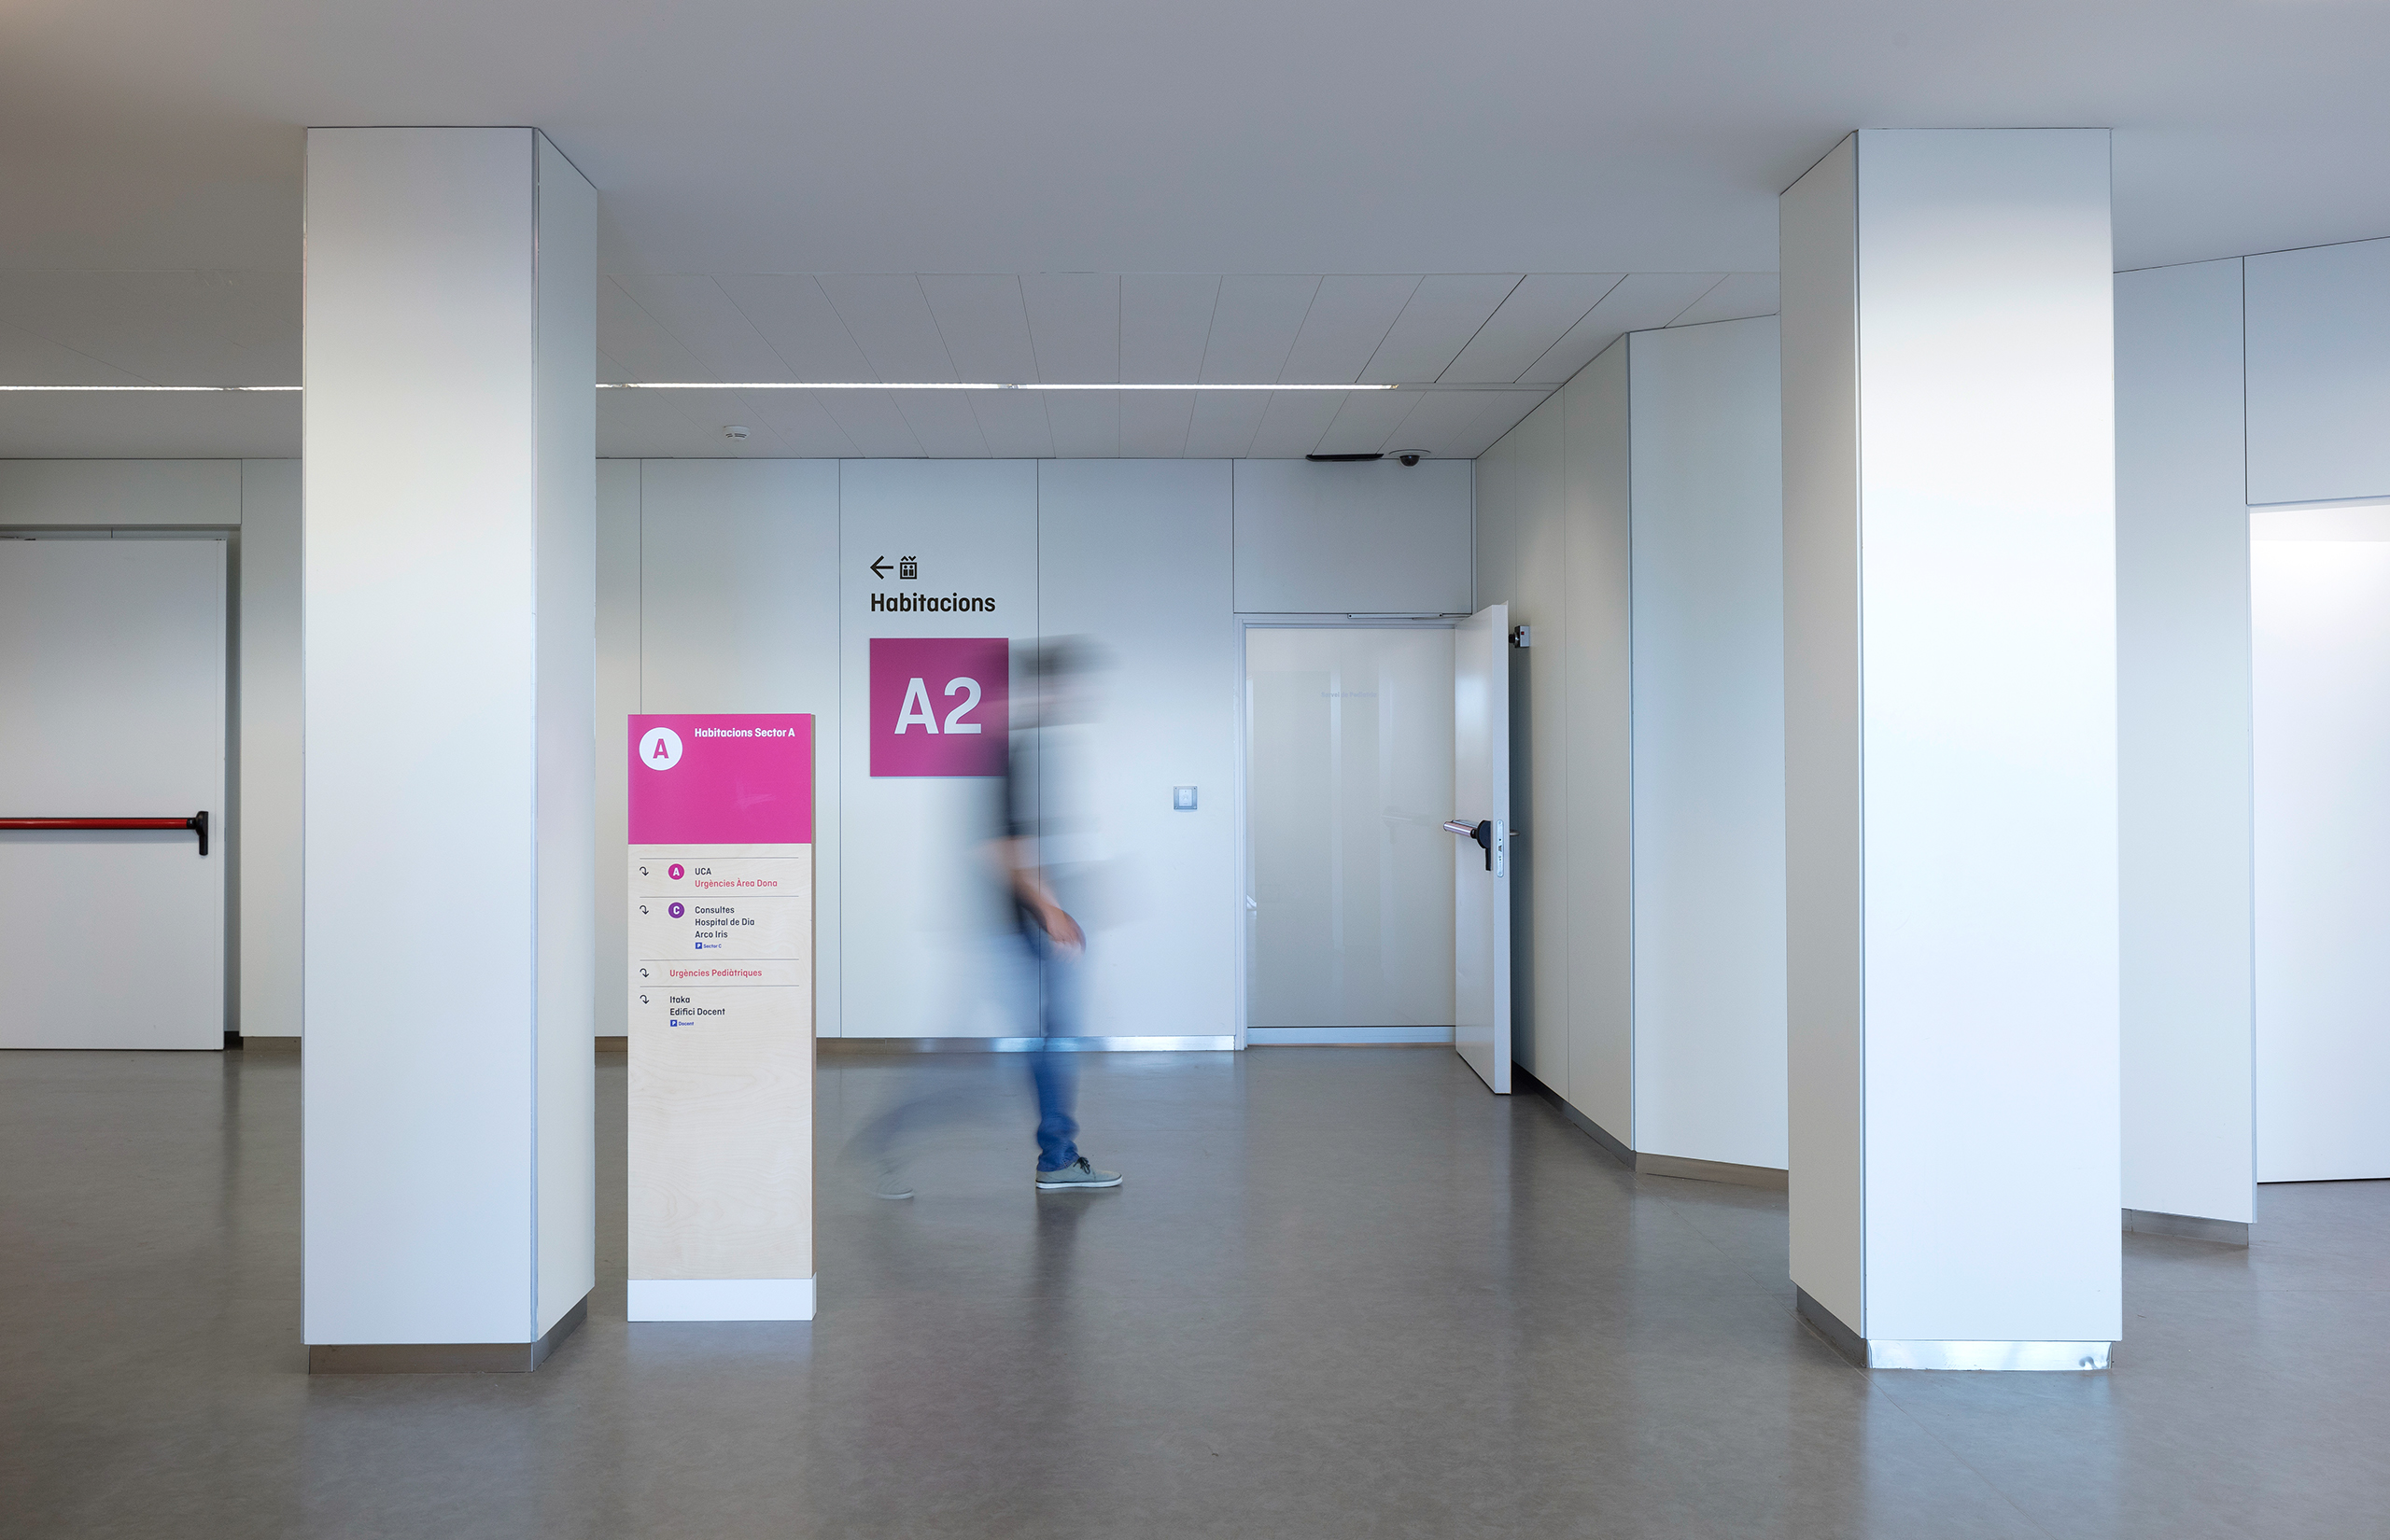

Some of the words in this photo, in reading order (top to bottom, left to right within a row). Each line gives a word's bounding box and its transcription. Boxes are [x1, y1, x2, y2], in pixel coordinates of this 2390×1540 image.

[870, 592, 996, 612] Habitacions
[893, 677, 983, 735] A2
[695, 727, 753, 737] Habitacions
[754, 727, 786, 737] Sector
[787, 728, 795, 737] A
[653, 738, 669, 759] A
[672, 867, 681, 876] A
[695, 867, 712, 875] UCA
[695, 879, 735, 889] Urgències
[736, 877, 755, 888] Àrea
[757, 879, 778, 888] Dona
[673, 905, 681, 915] C
[695, 905, 736, 915] Consultes
[695, 917, 728, 928] Hospital
[730, 917, 740, 926] de
[741, 917, 755, 926] Dia
[695, 930, 713, 939] Arco
[715, 930, 728, 939] Iris
[669, 969, 710, 979] Urgències
[711, 968, 763, 978] Pediàtriques
[669, 995, 691, 1004] Itaka
[669, 1007, 696, 1016] Edifici
[696, 1007, 726, 1016] Docent
